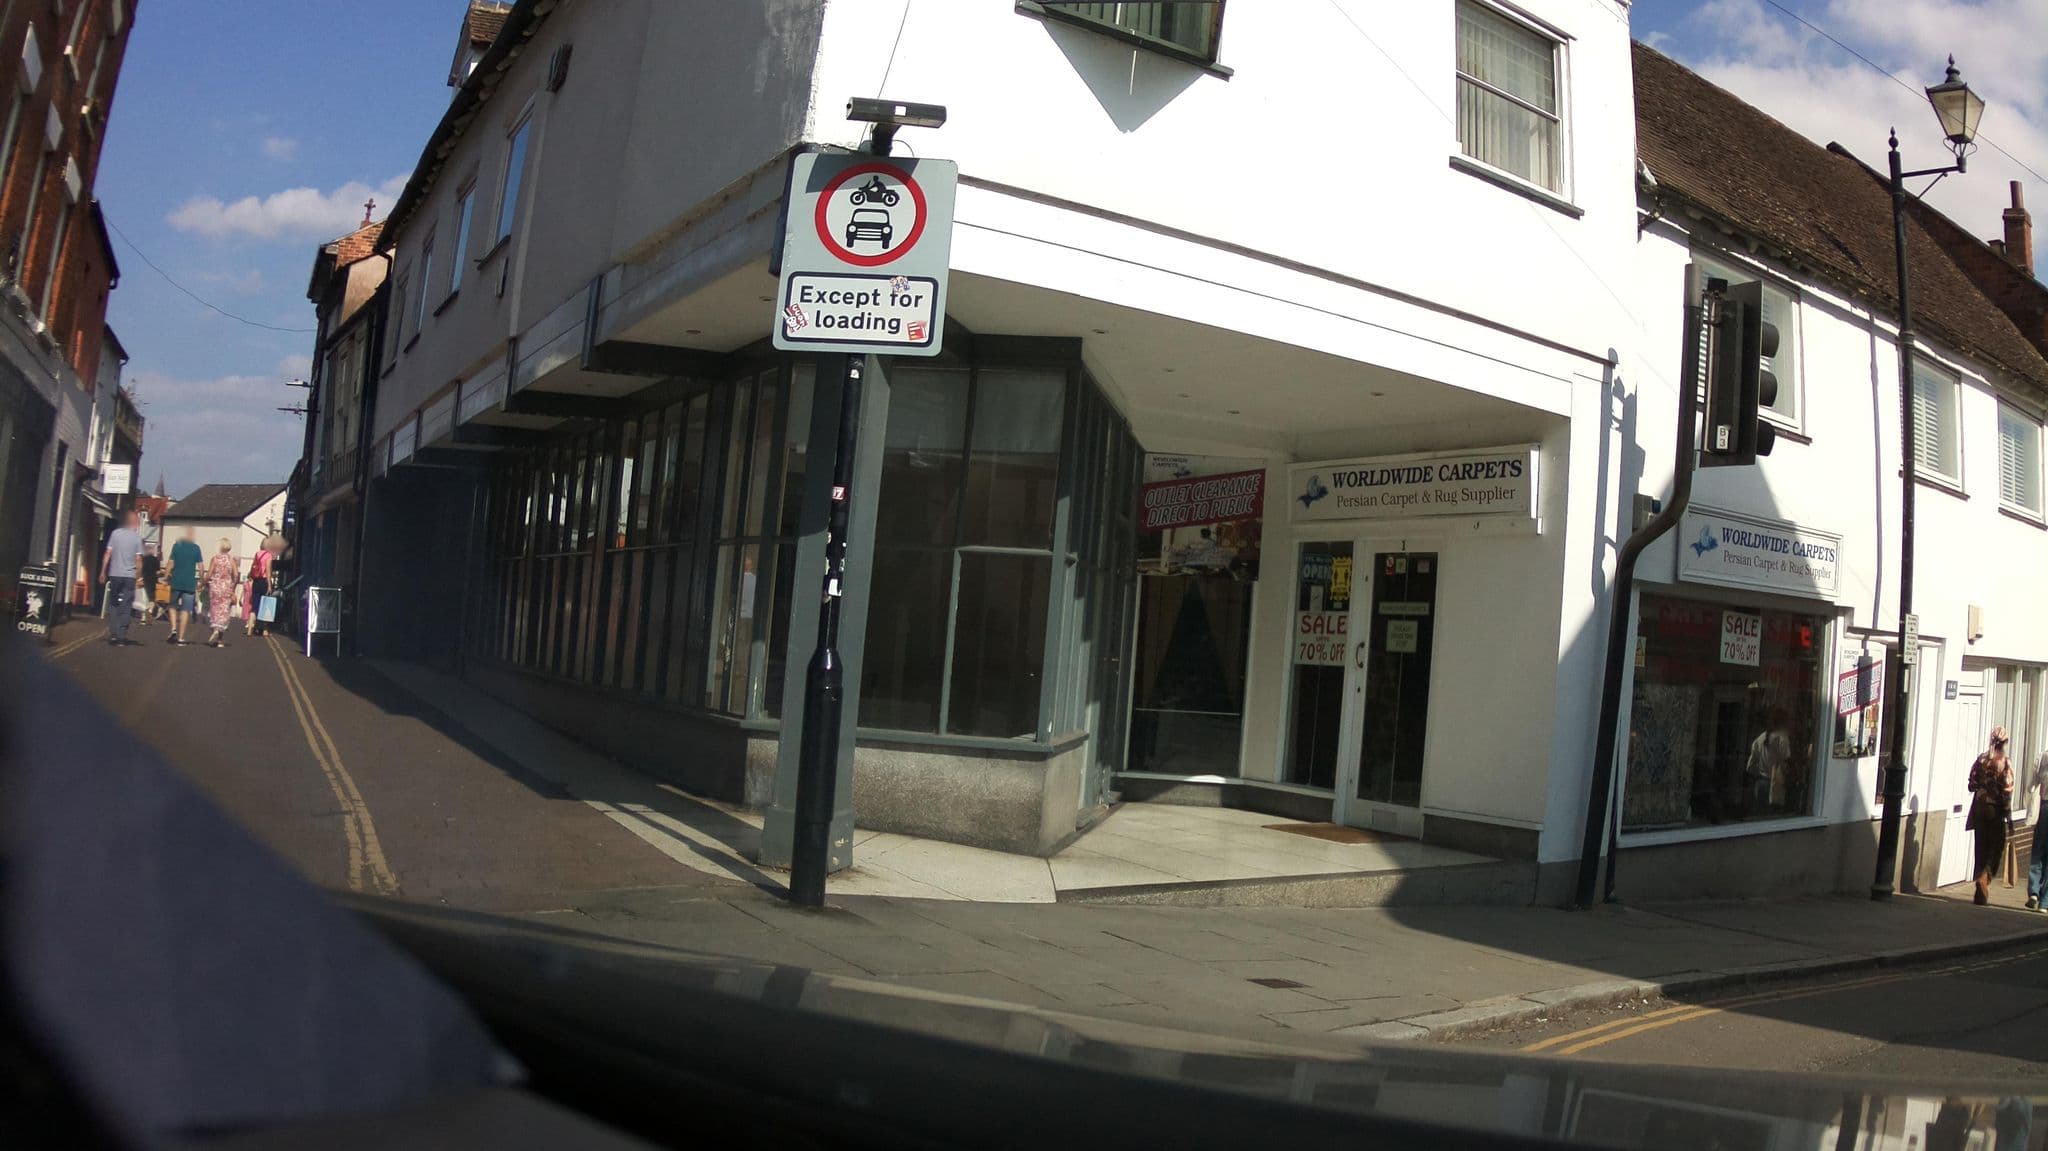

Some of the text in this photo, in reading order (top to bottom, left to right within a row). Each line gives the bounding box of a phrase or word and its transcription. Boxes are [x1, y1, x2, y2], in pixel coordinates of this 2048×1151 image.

[800, 285, 924, 309] Except for
[815, 310, 902, 335] loading
[1332, 459, 1523, 489] WORLDWIDE CARPETS
[1144, 473, 1262, 509] OUTLET CLEARANCE
[1336, 486, 1517, 510] Persian Carpet & Rug Supplier
[1146, 494, 1257, 527] DIRECT TO PUBLIC
[1721, 527, 1836, 563] WORLDWIDE CARPETS
[1723, 550, 1832, 581] Persian Carpet & Rug Supplier
[17, 621, 46, 635] OPEN
[1301, 614, 1347, 635] SALE
[1725, 614, 1759, 638] SALE
[1300, 643, 1346, 662] 70% OFF
[1724, 642, 1758, 662] 70% OFF
